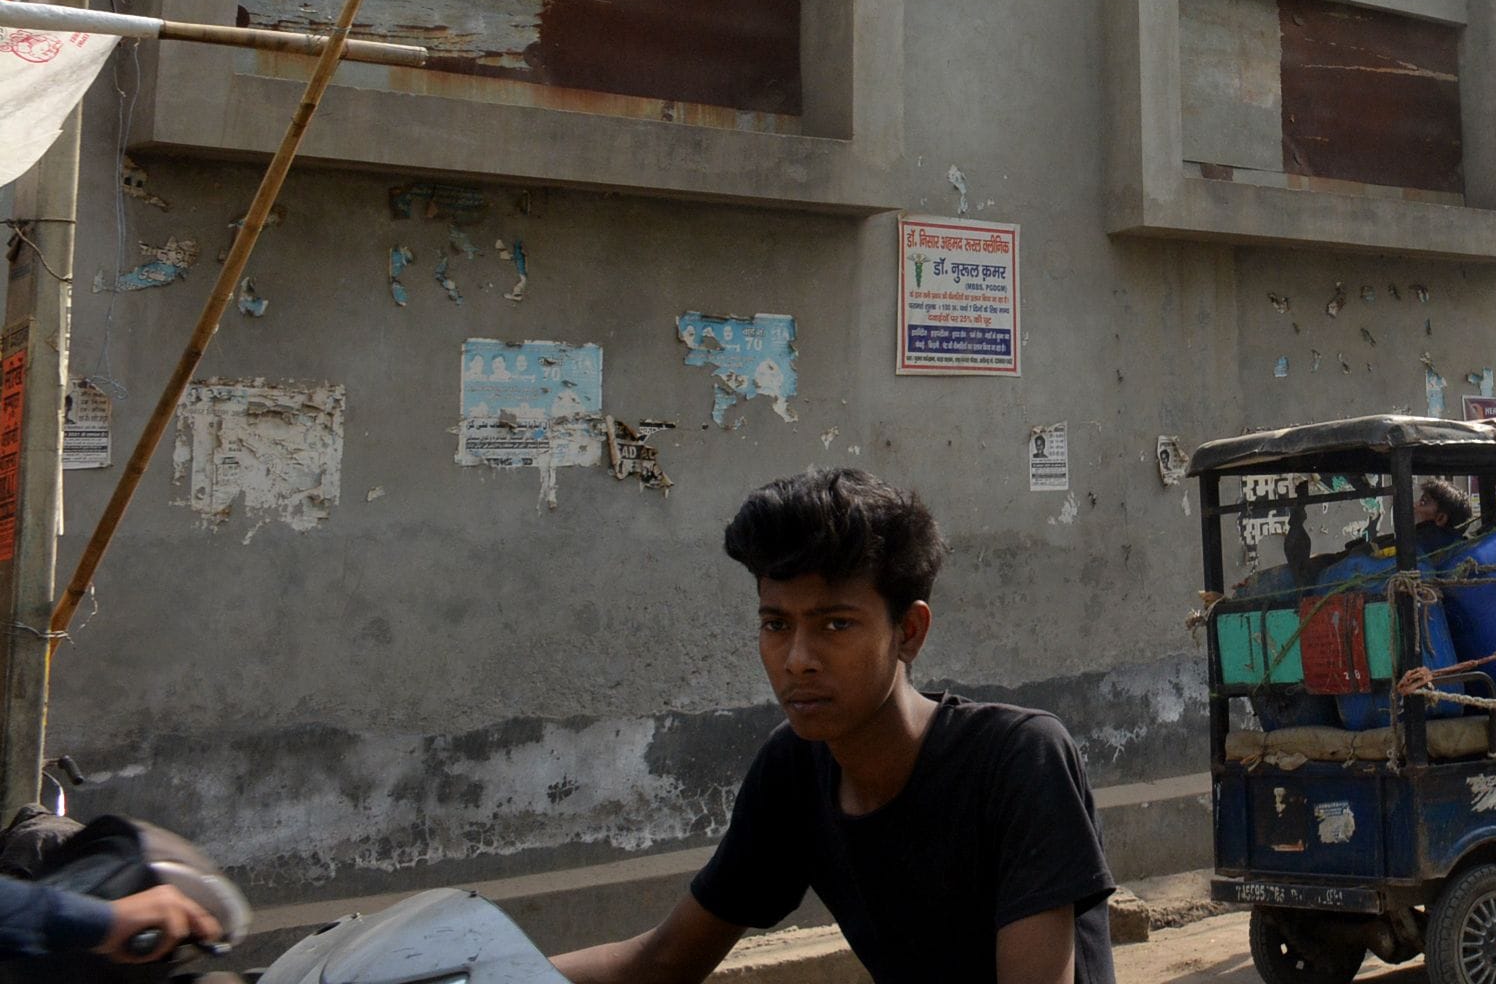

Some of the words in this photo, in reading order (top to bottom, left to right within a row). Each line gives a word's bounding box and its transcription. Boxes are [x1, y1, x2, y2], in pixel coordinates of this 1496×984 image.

[907, 229, 917, 248] डॉ.
[919, 229, 939, 249] निसार
[941, 236, 963, 251] अहमद
[933, 257, 948, 276] डॉ.
[745, 337, 763, 351] 70
